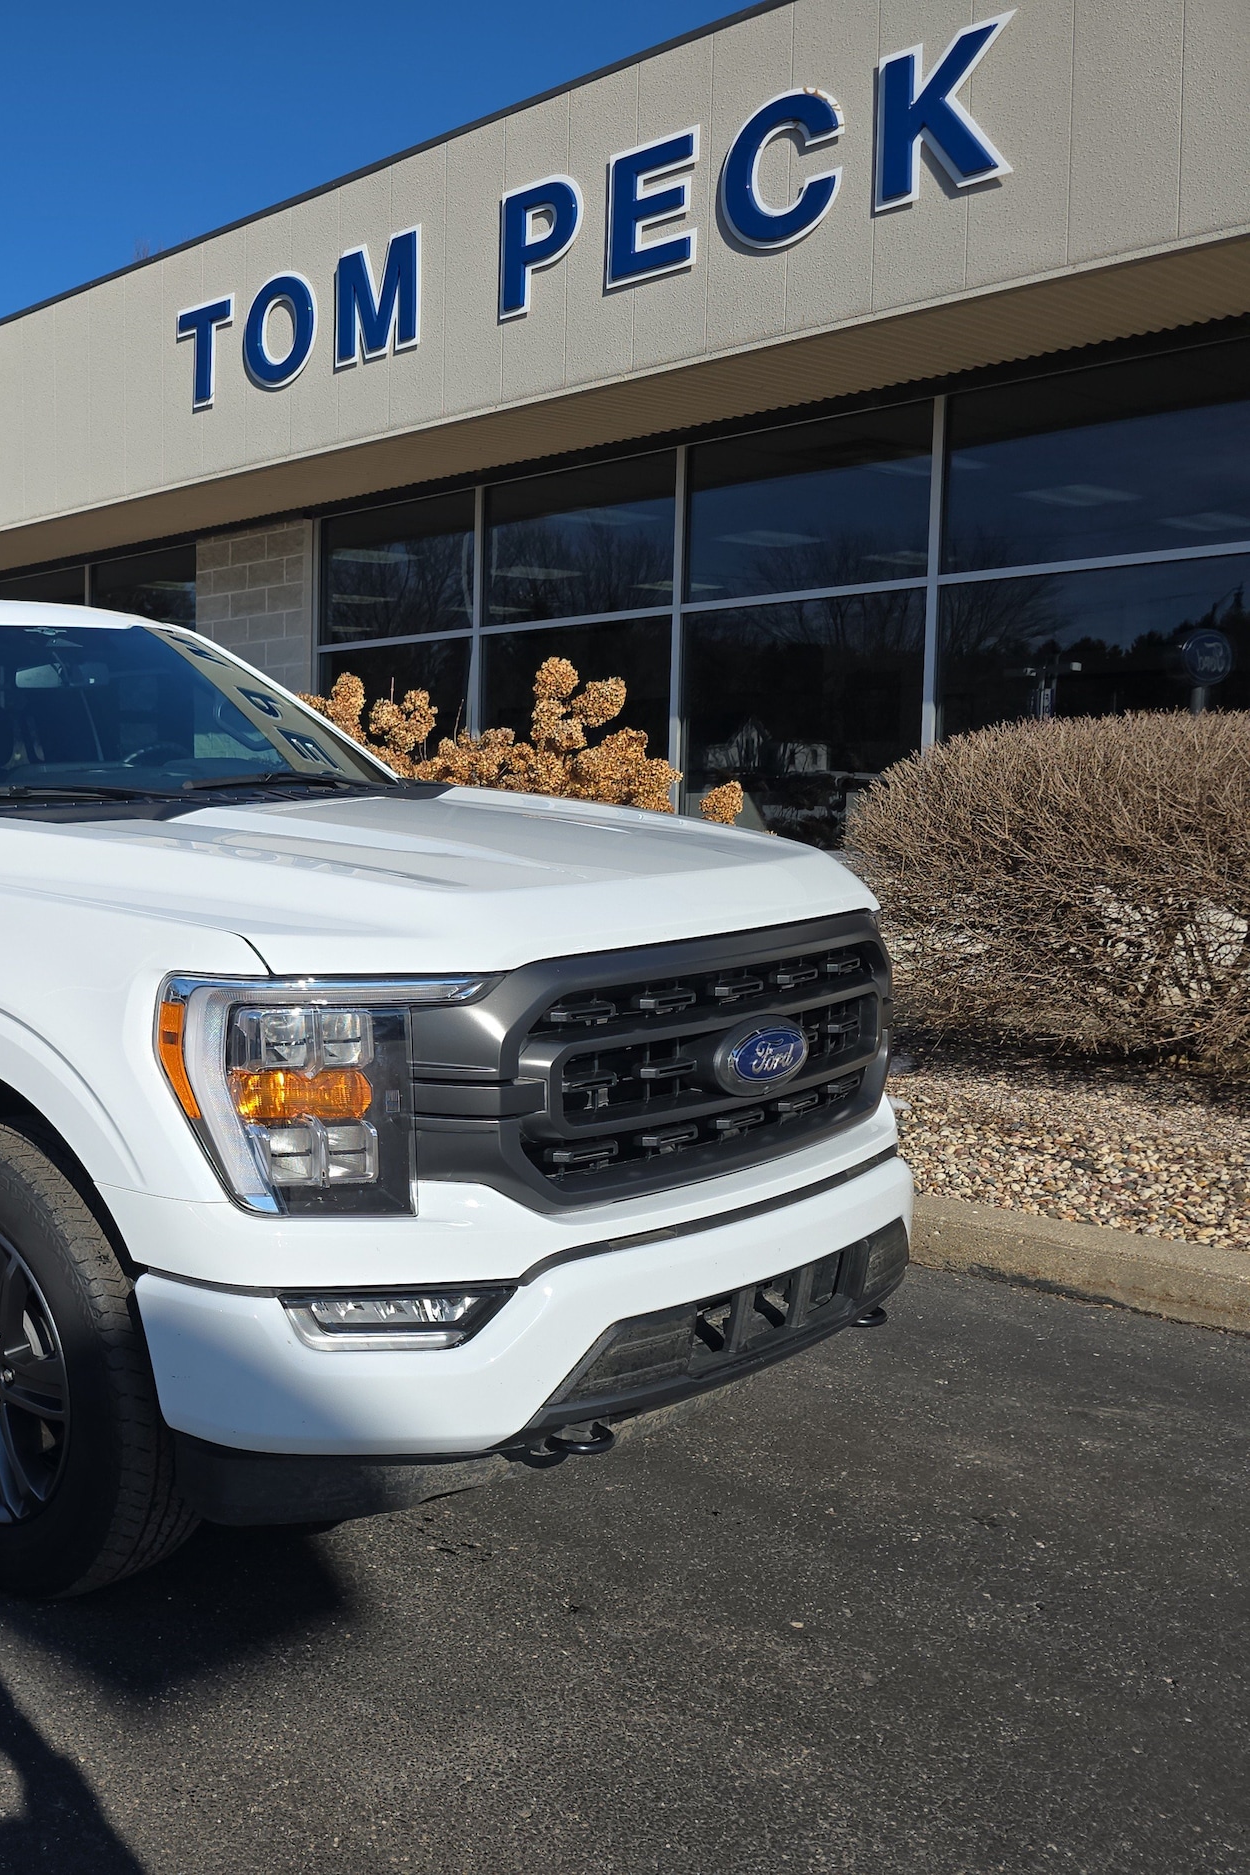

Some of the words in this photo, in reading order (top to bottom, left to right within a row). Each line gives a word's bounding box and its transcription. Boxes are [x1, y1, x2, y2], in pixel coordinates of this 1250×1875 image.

[176, 223, 422, 409] TOM
[498, 9, 1018, 321] PECK
[751, 1037, 795, 1075] Ford
